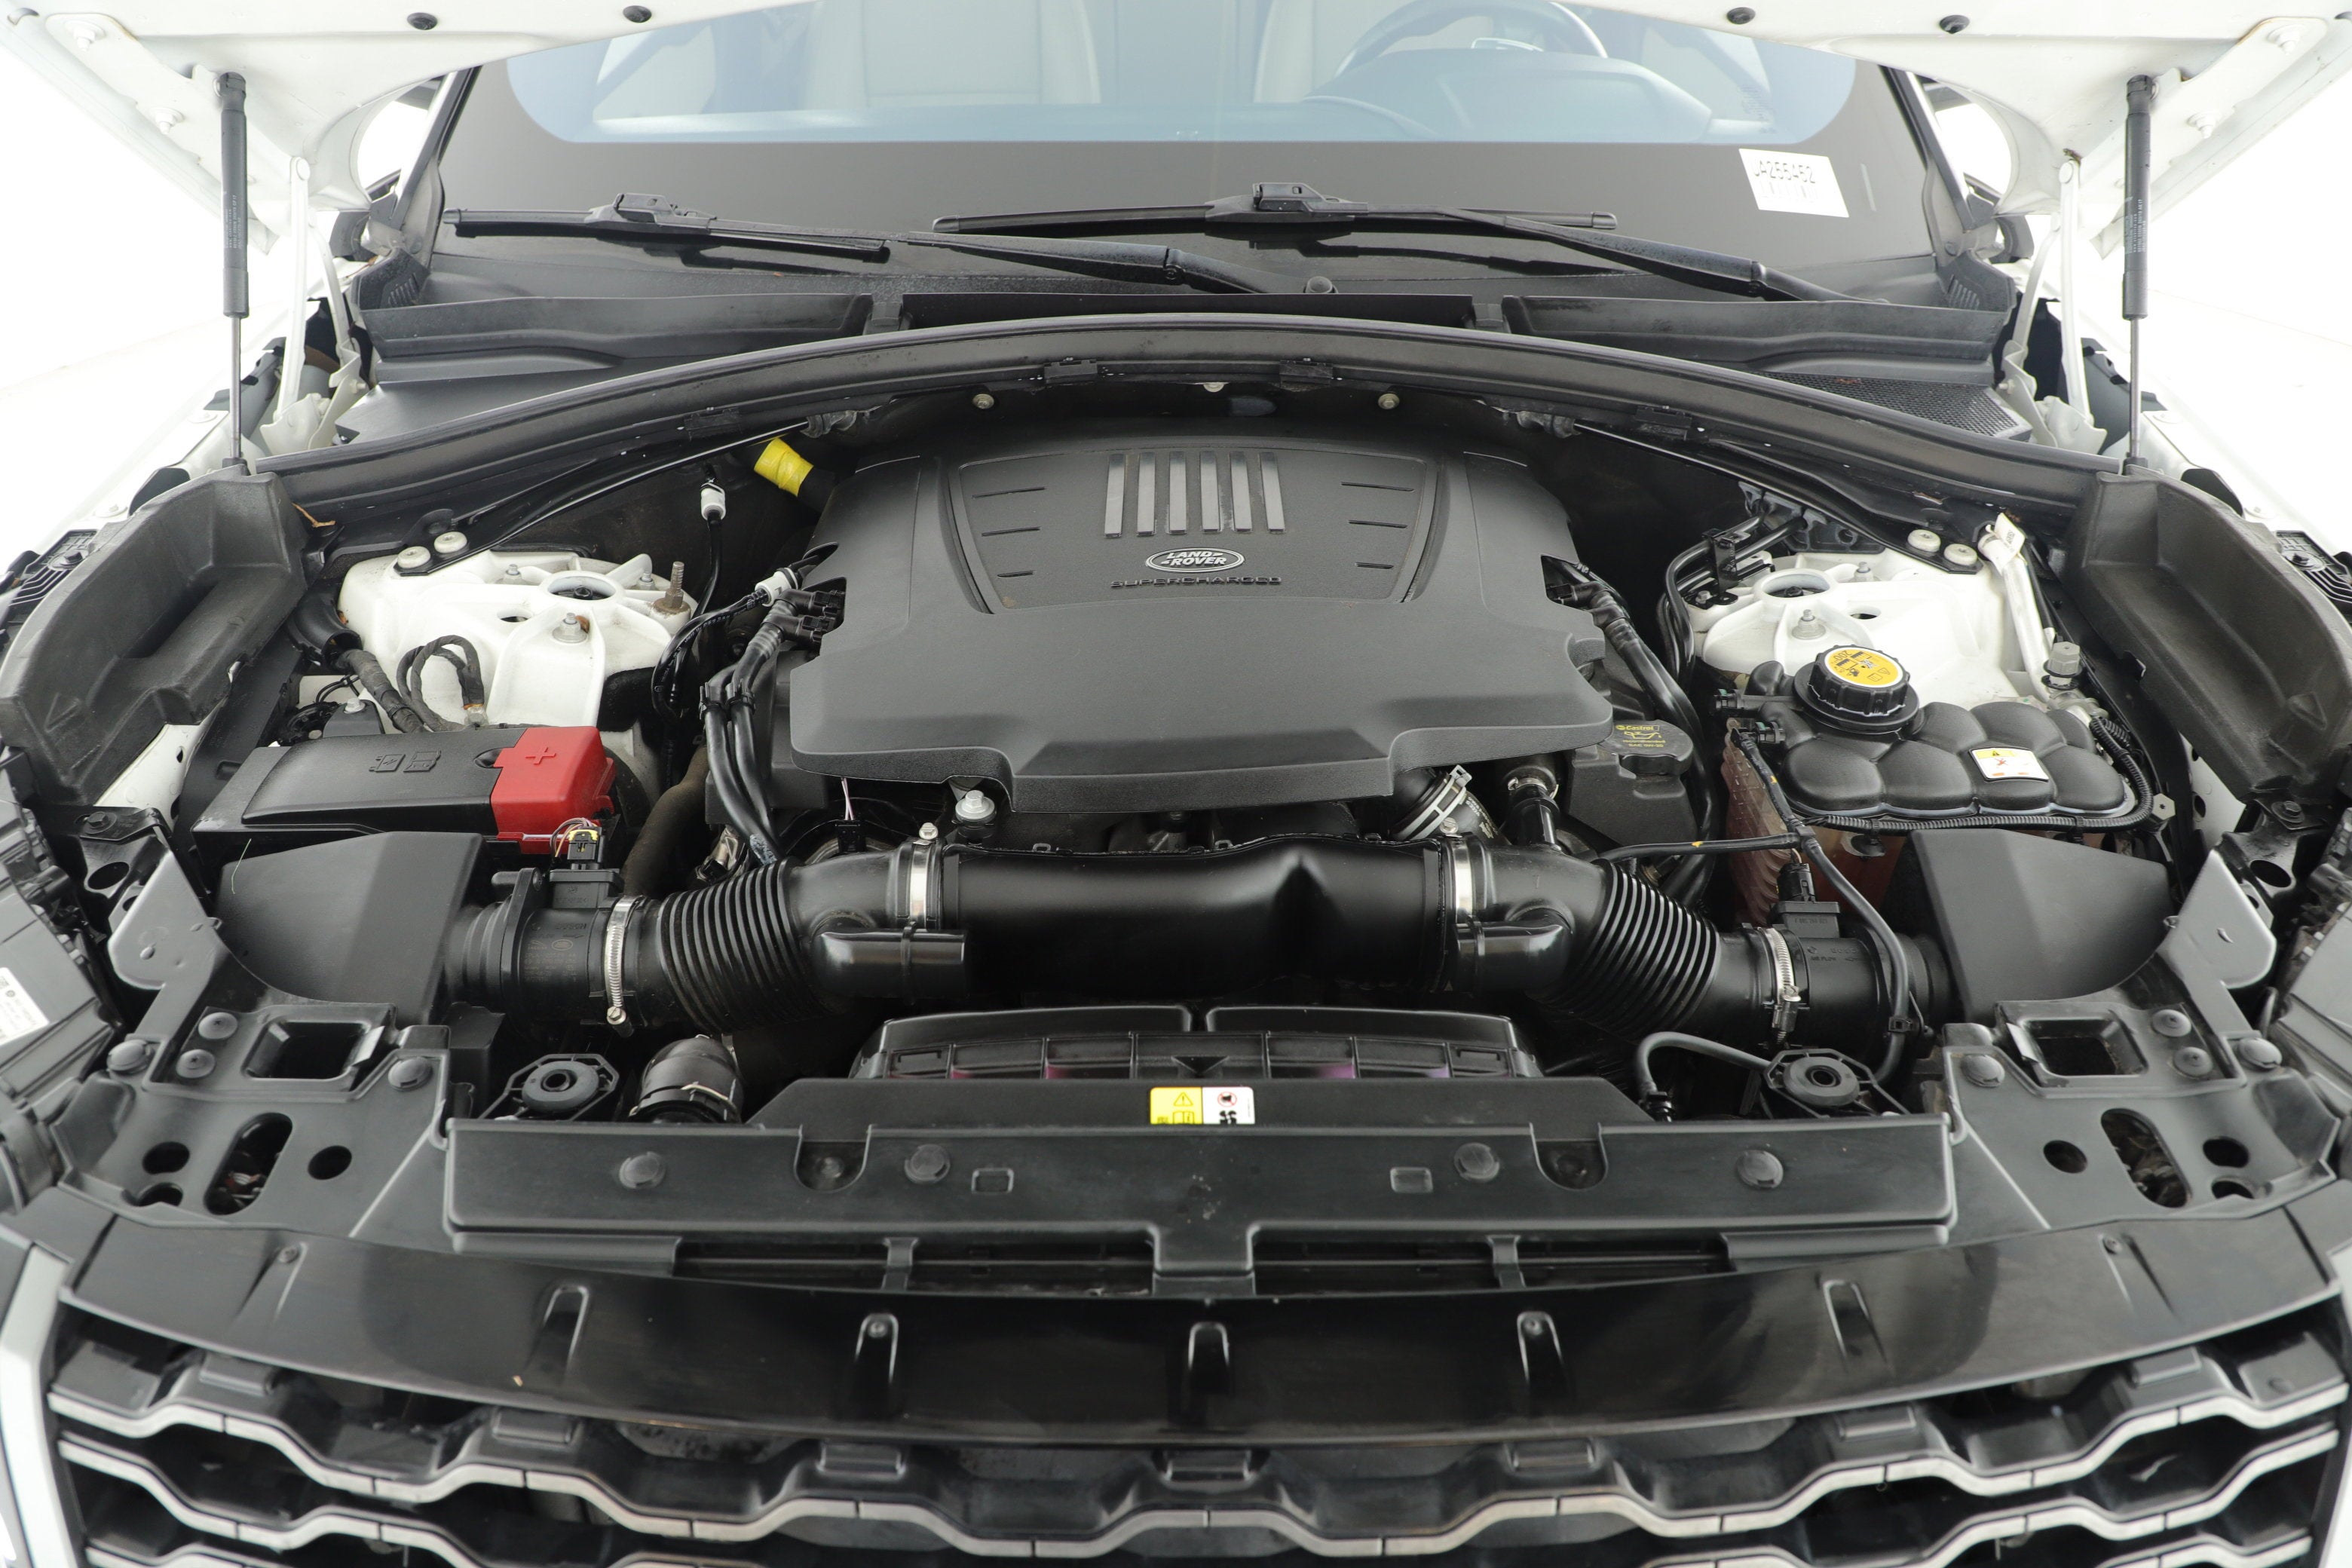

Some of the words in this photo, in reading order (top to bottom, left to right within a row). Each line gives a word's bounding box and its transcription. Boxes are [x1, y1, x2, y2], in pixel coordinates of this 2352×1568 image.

[1165, 550, 1213, 559] LAND
[1169, 556, 1227, 566] ROVER
[1110, 576, 1283, 589] SUPERCHARGED
